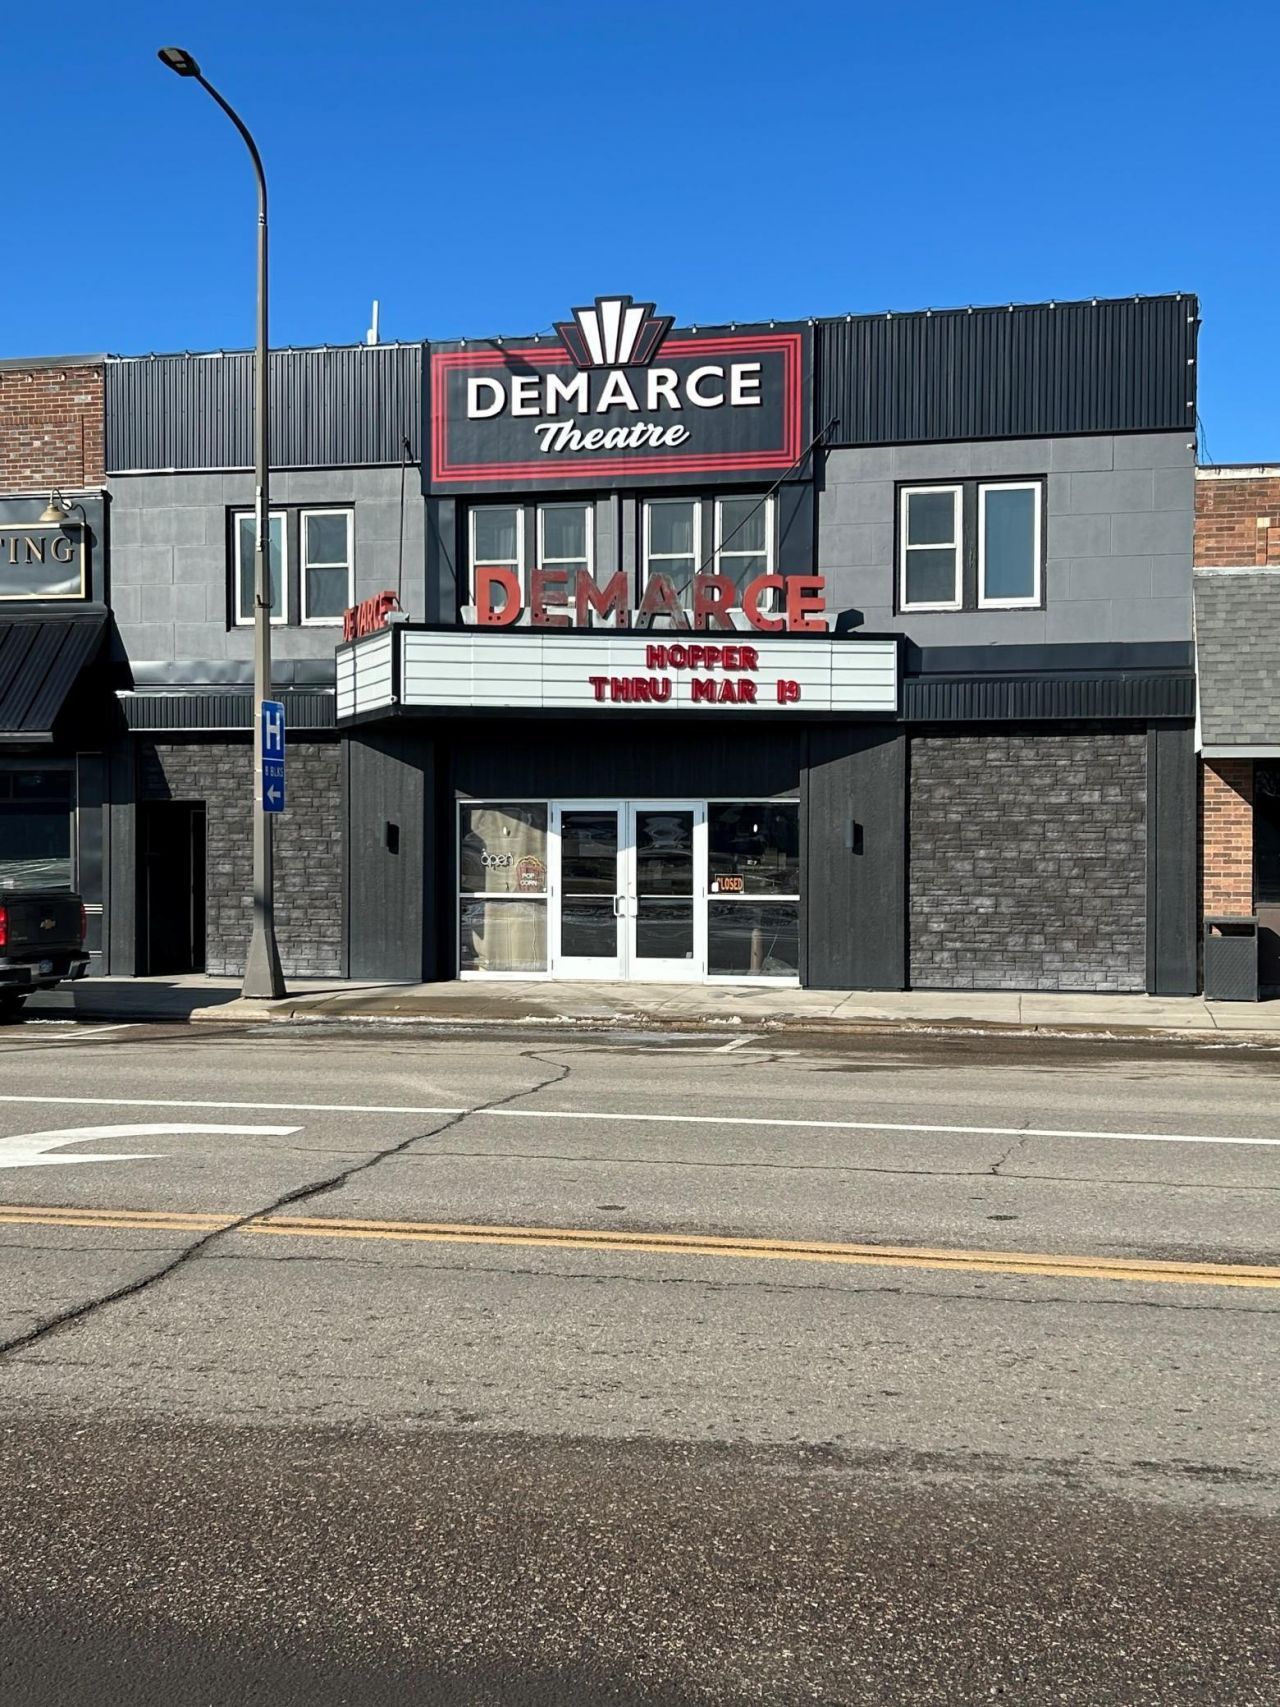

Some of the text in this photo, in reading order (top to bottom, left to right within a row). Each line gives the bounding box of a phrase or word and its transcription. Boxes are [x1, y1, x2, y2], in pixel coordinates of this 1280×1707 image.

[467, 362, 762, 419] DEMARCE
[534, 418, 690, 453] Theatre
[0, 536, 76, 564] ING
[475, 567, 826, 633] DEMARCE
[646, 644, 759, 671] HOPPER
[589, 676, 800, 704] THRU MAR 19
[266, 711, 280, 750] H
[481, 852, 514, 868] open
